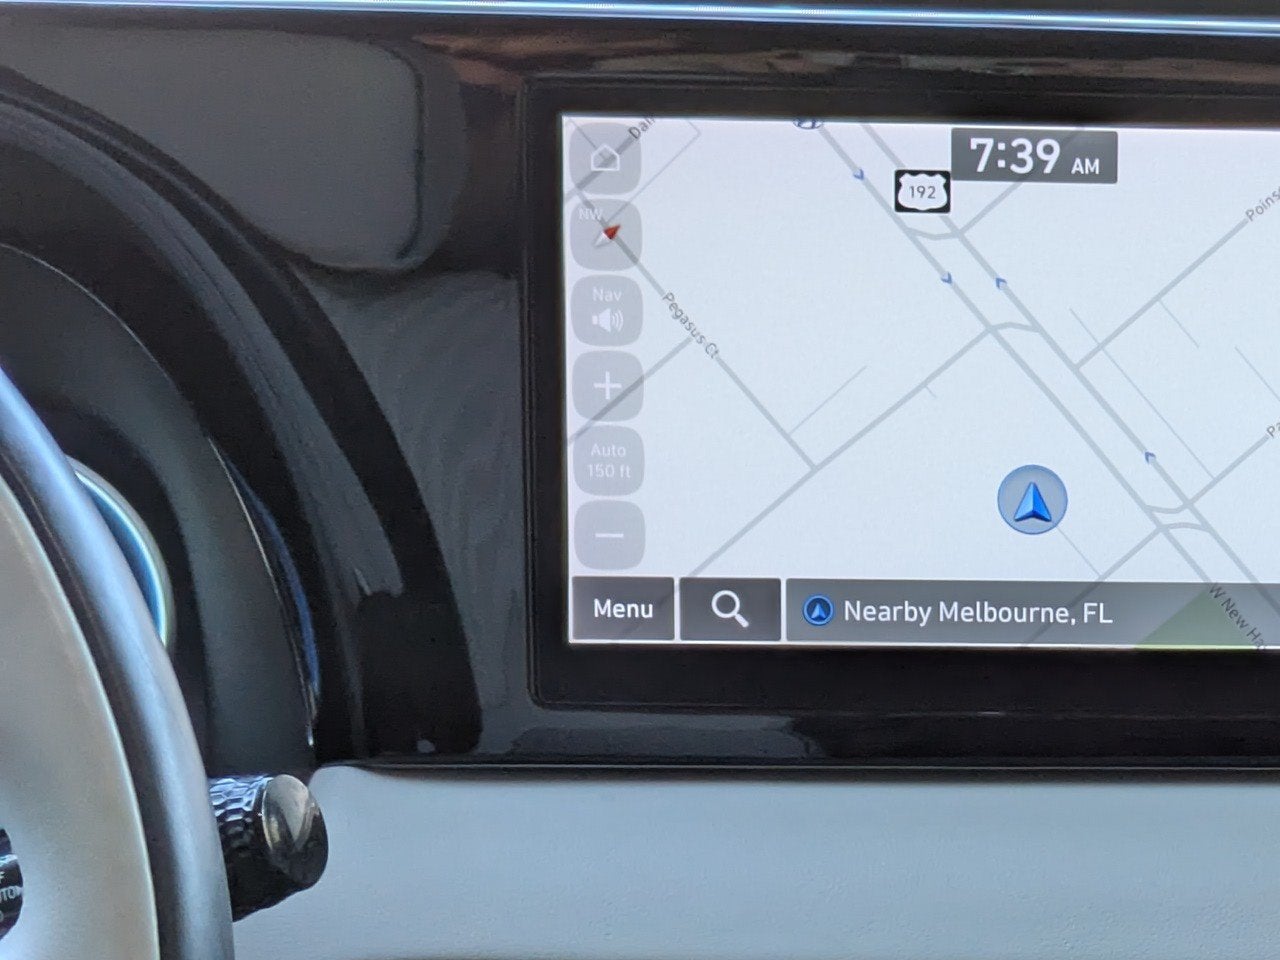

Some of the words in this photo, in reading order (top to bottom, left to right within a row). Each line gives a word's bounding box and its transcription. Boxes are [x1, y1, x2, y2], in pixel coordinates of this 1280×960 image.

[969, 137, 1061, 174] 7:39
[1070, 158, 1100, 175] AM
[908, 185, 936, 199] 192
[592, 286, 622, 301] Nav
[662, 291, 706, 345] Pegasus
[704, 342, 720, 359] Ct
[590, 443, 627, 458] Auto
[587, 464, 615, 479] 150
[619, 464, 632, 479] ft
[593, 598, 654, 618] Menu
[844, 600, 932, 627] Nearby
[939, 601, 1076, 626] Melbourne,
[1083, 602, 1114, 623] FL
[1208, 583, 1227, 599] W
[1221, 598, 1249, 629] New
